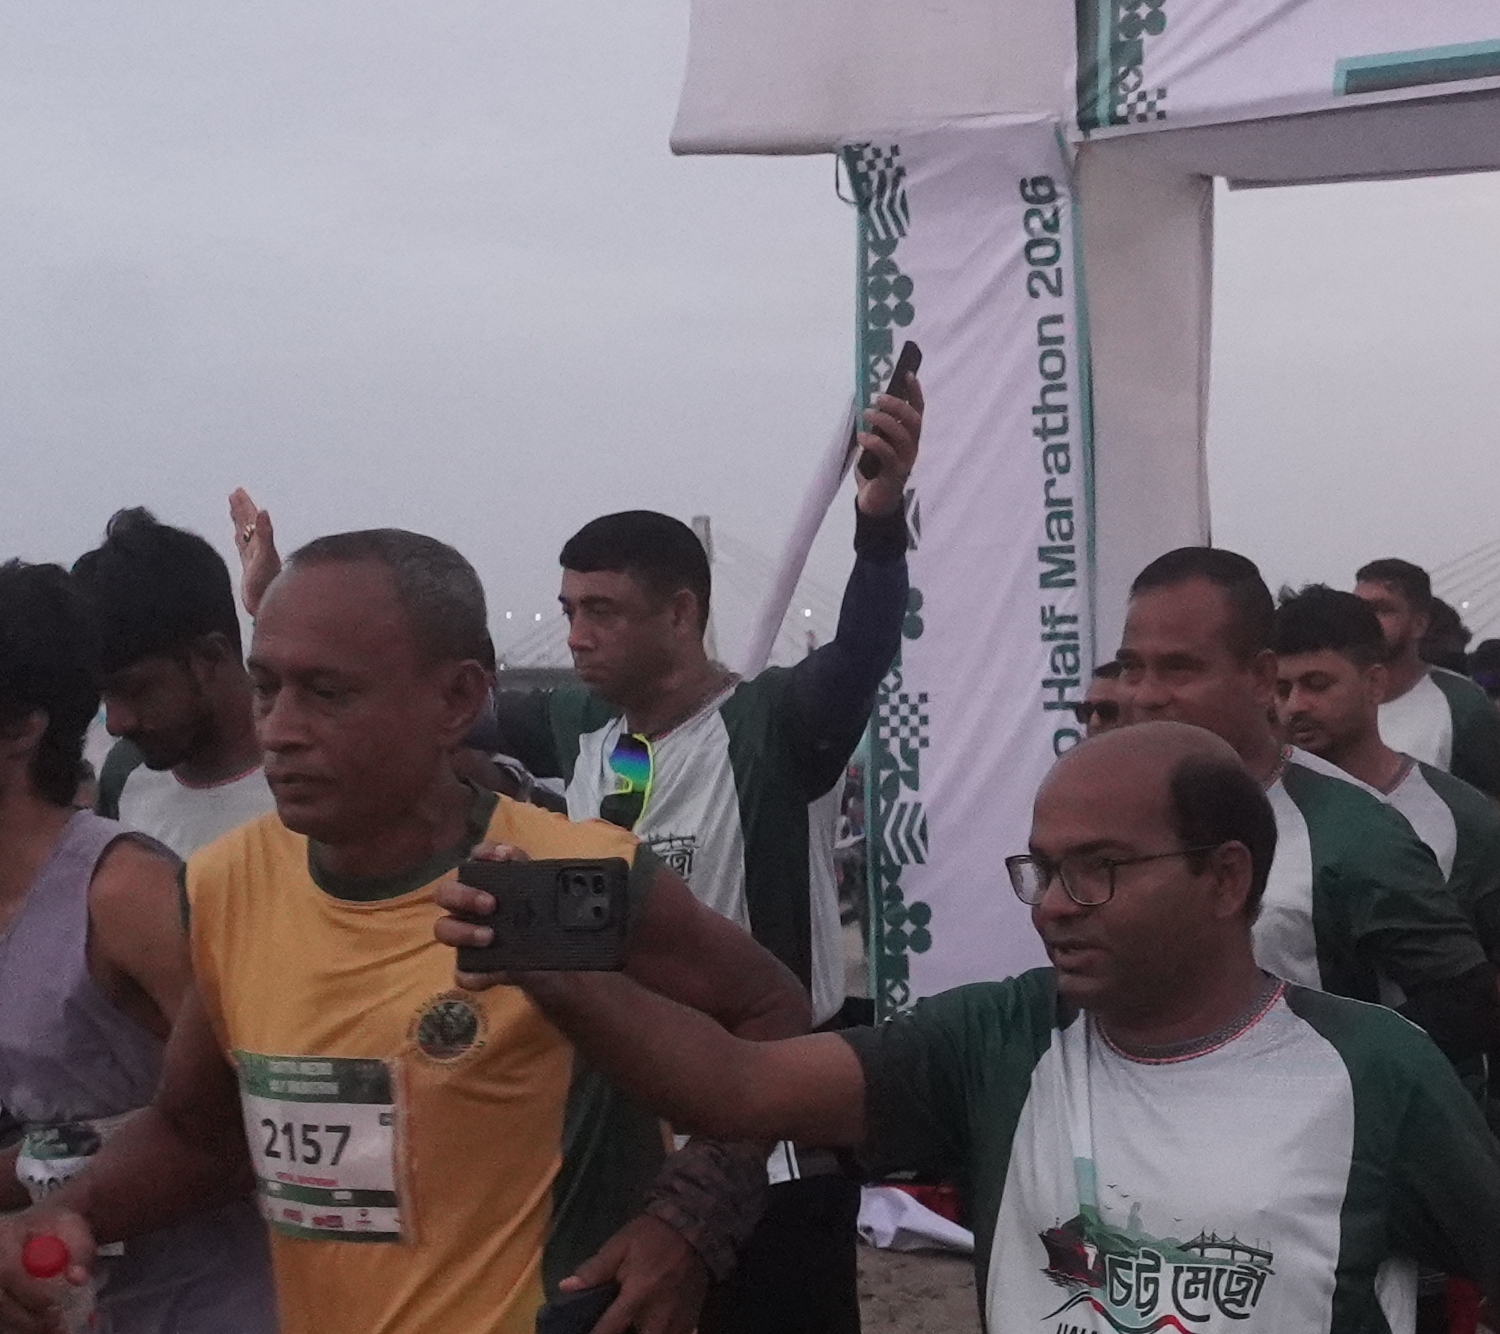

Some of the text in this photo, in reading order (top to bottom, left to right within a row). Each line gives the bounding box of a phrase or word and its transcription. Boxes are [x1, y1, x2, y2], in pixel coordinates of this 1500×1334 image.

[1020, 175, 1064, 299] 2026
[1032, 314, 1076, 588] Marathon
[1040, 605, 1081, 710] Half
[261, 1118, 351, 1166] 2157
[1172, 1264, 1276, 1322] মেট্রো
